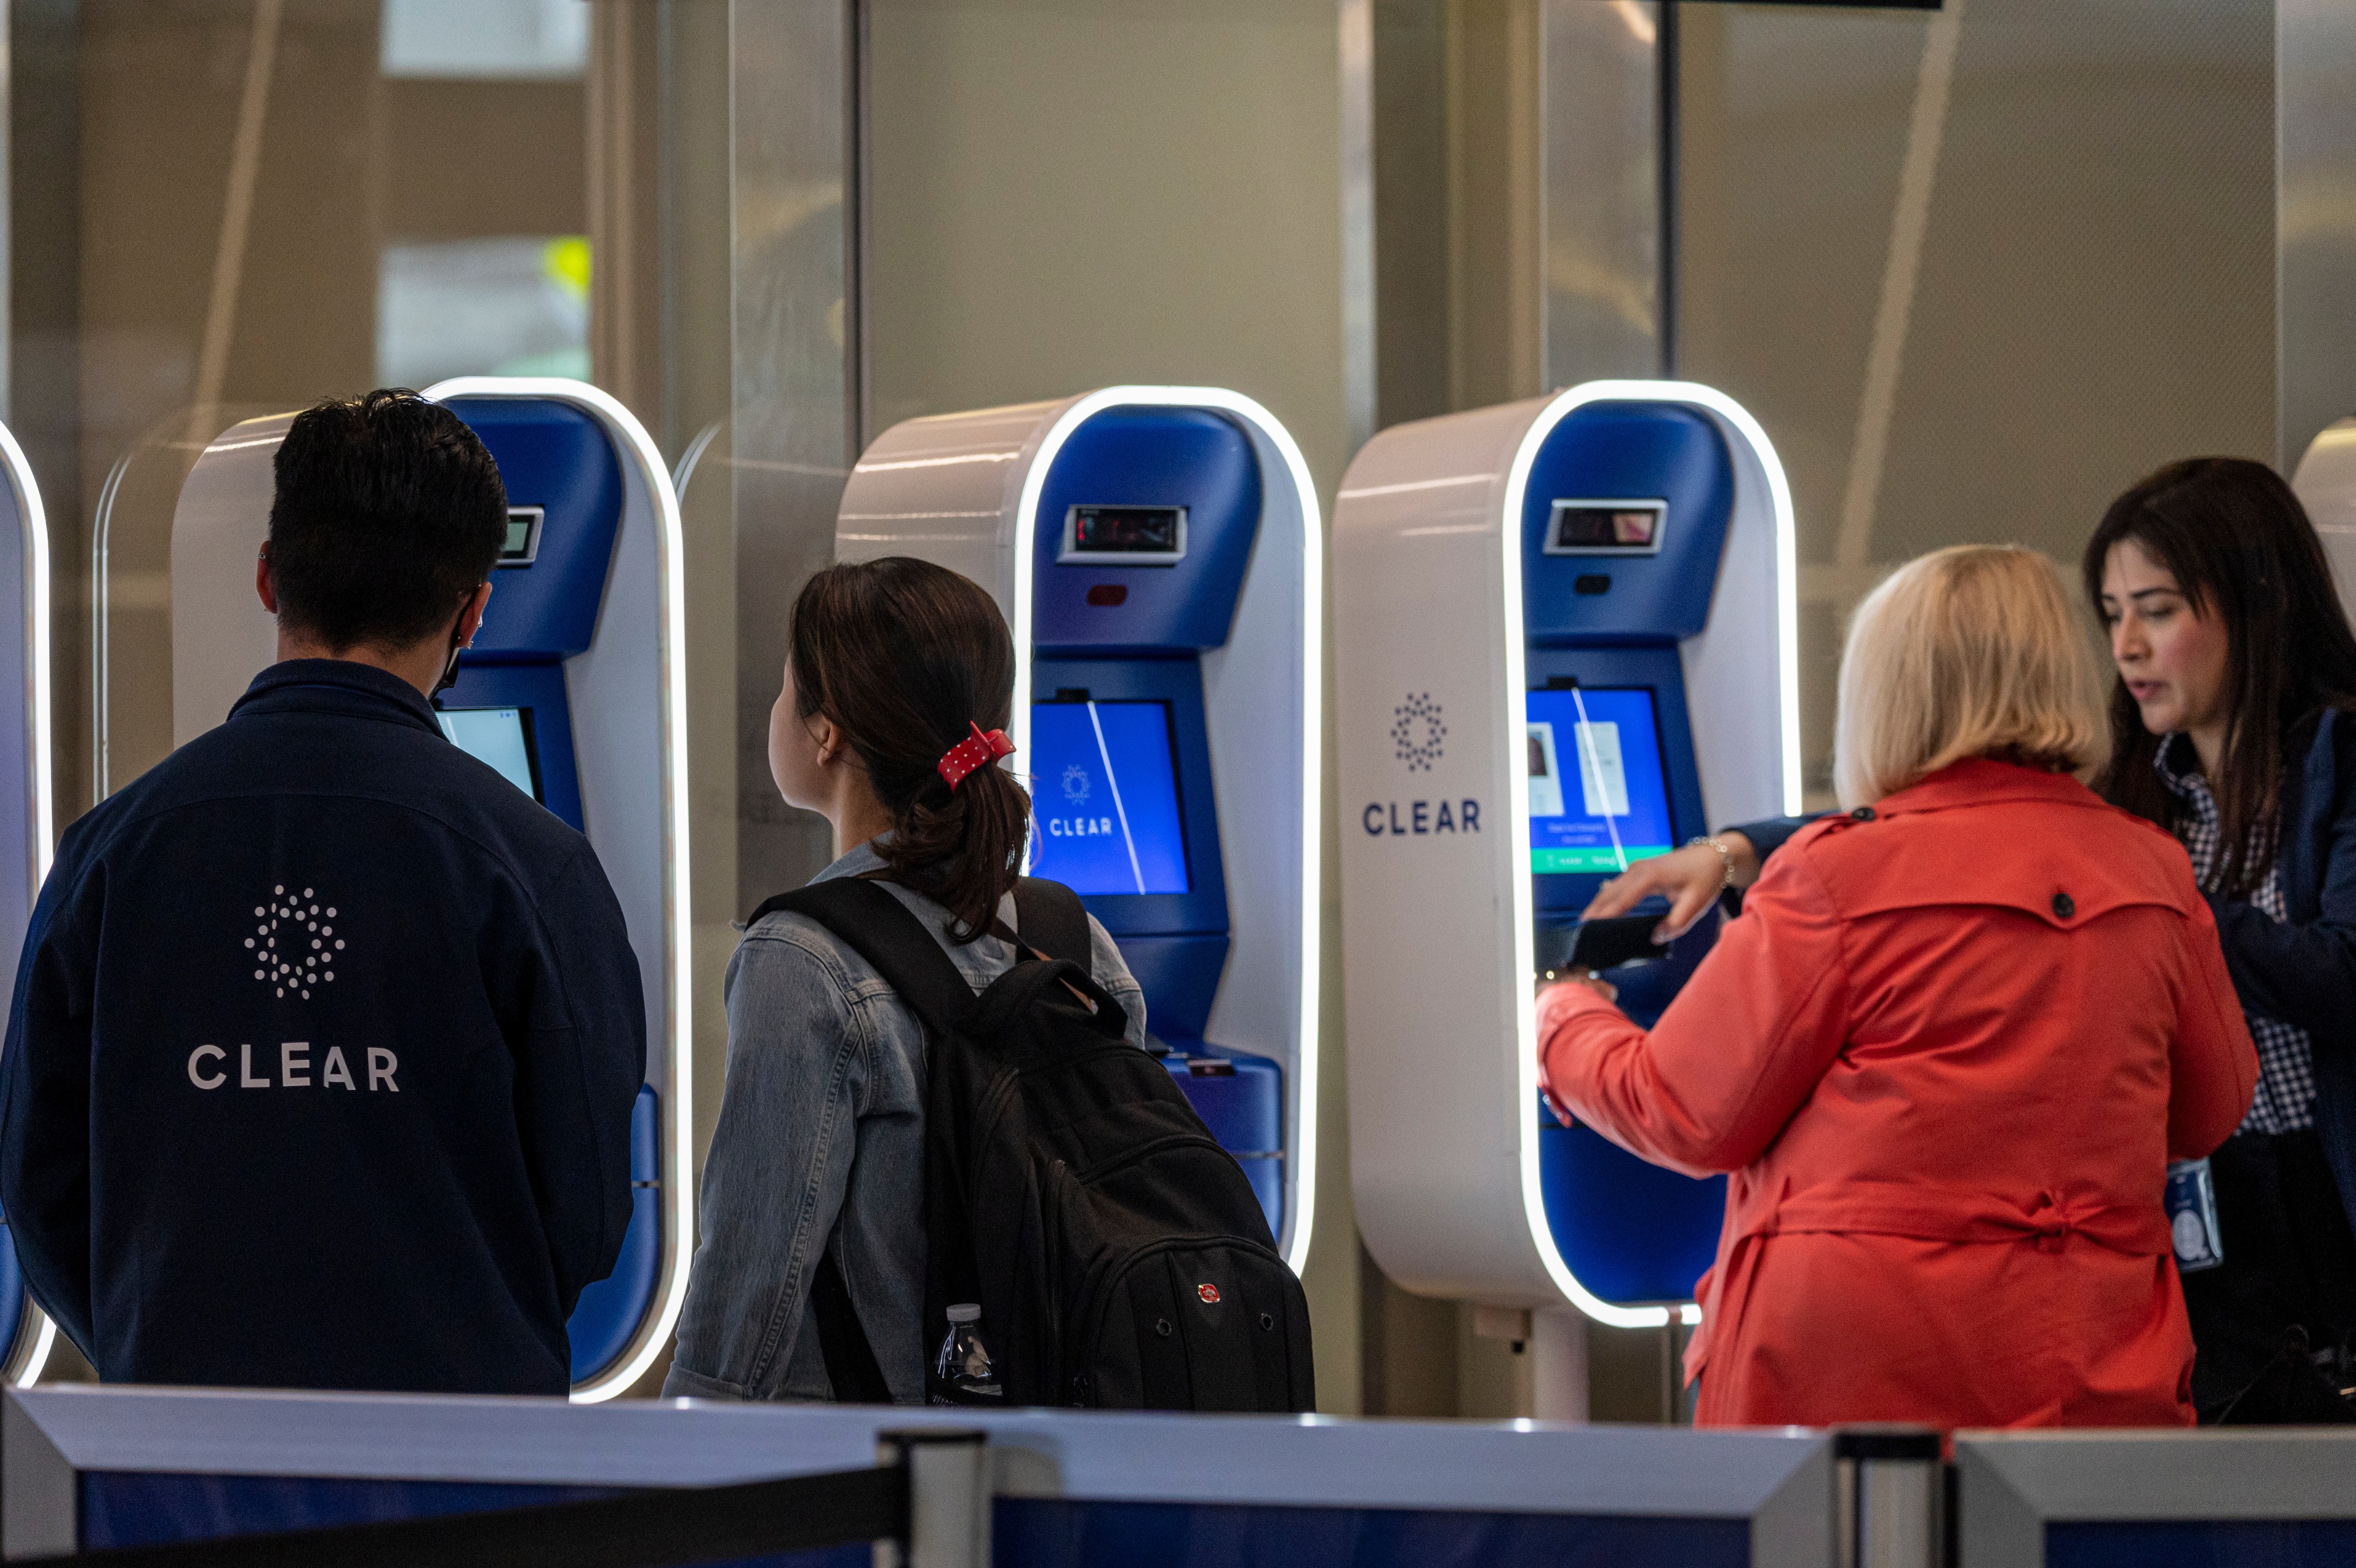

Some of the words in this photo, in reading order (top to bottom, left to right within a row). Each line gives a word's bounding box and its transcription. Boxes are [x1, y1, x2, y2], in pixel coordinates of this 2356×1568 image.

[1050, 817, 1112, 836] CLEAR
[1362, 799, 1481, 836] CLEAR
[188, 1042, 399, 1092] CLEAR
